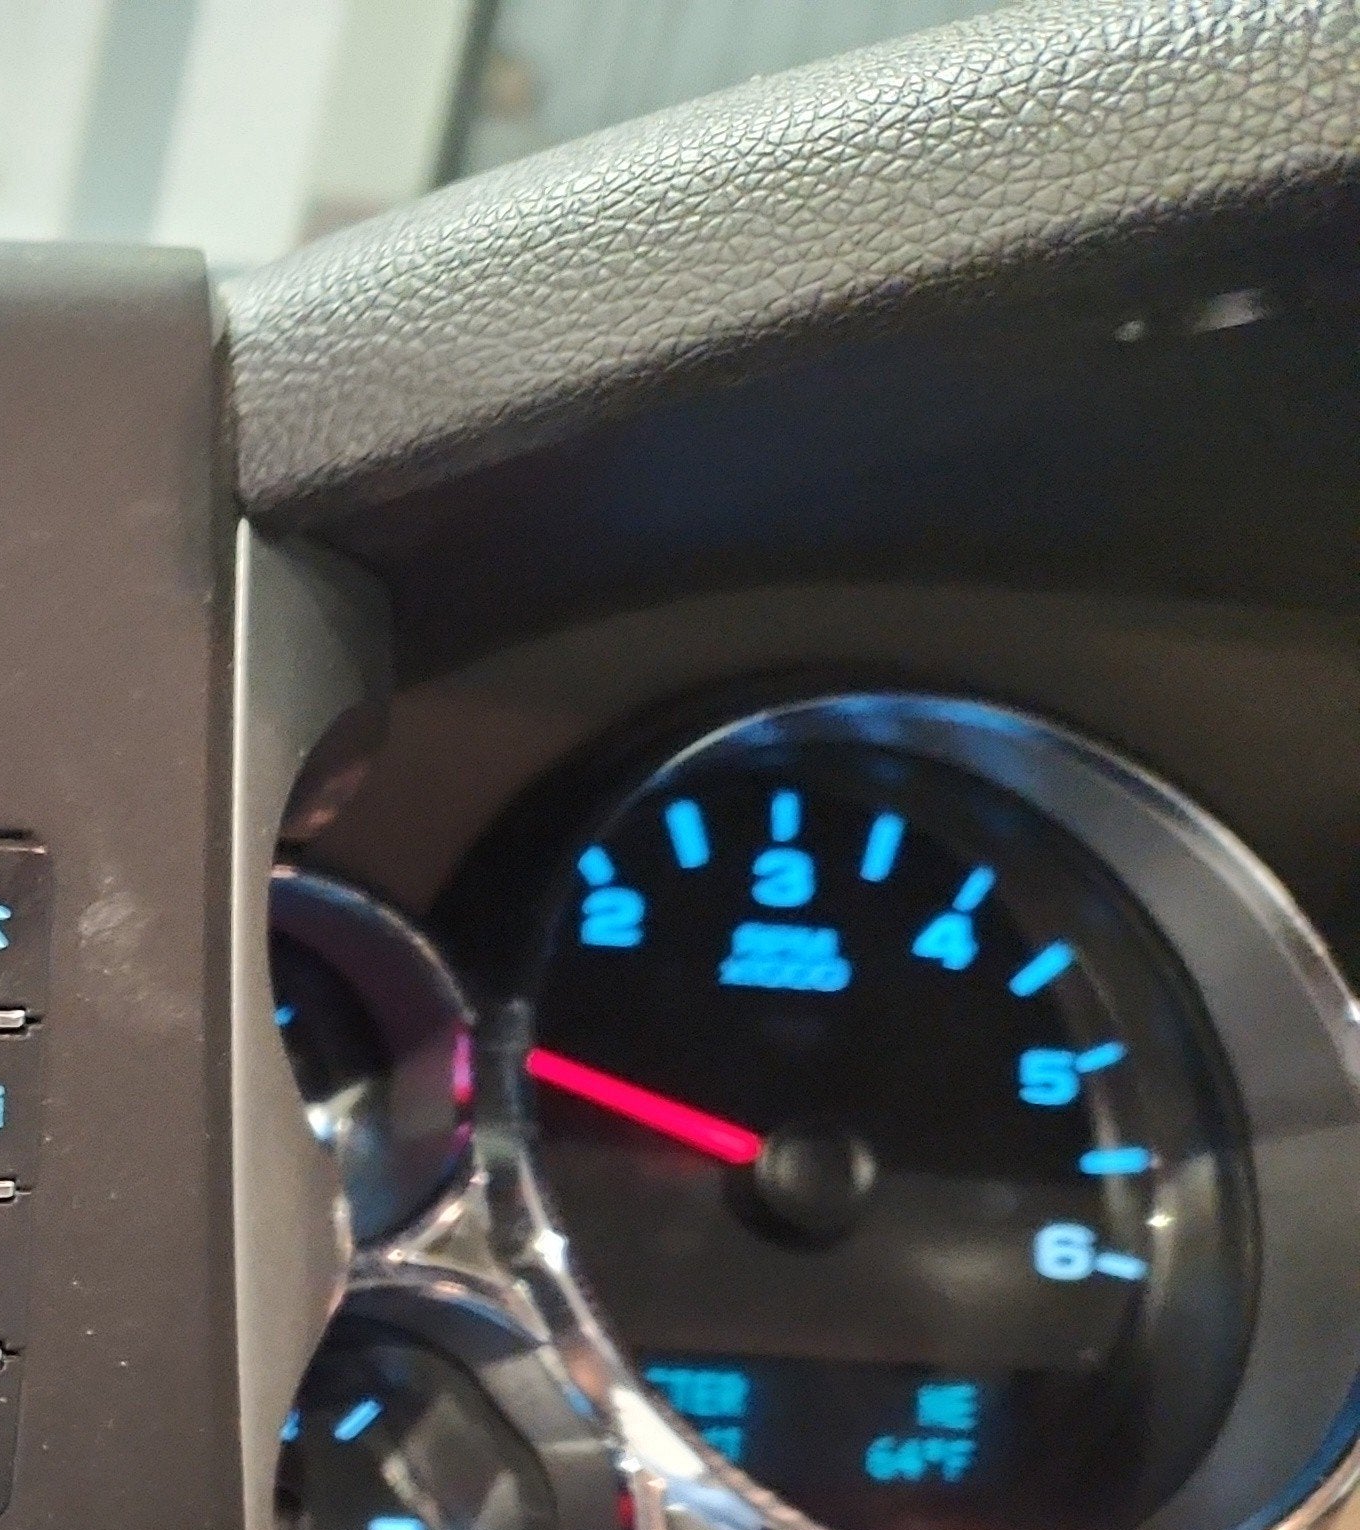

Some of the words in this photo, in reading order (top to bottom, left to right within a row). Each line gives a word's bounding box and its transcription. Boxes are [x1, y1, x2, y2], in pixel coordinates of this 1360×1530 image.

[751, 846, 816, 910] 3
[580, 884, 645, 948] 2
[911, 912, 978, 972] 4
[1018, 1048, 1078, 1107] 5
[1032, 1222, 1098, 1281] 6
